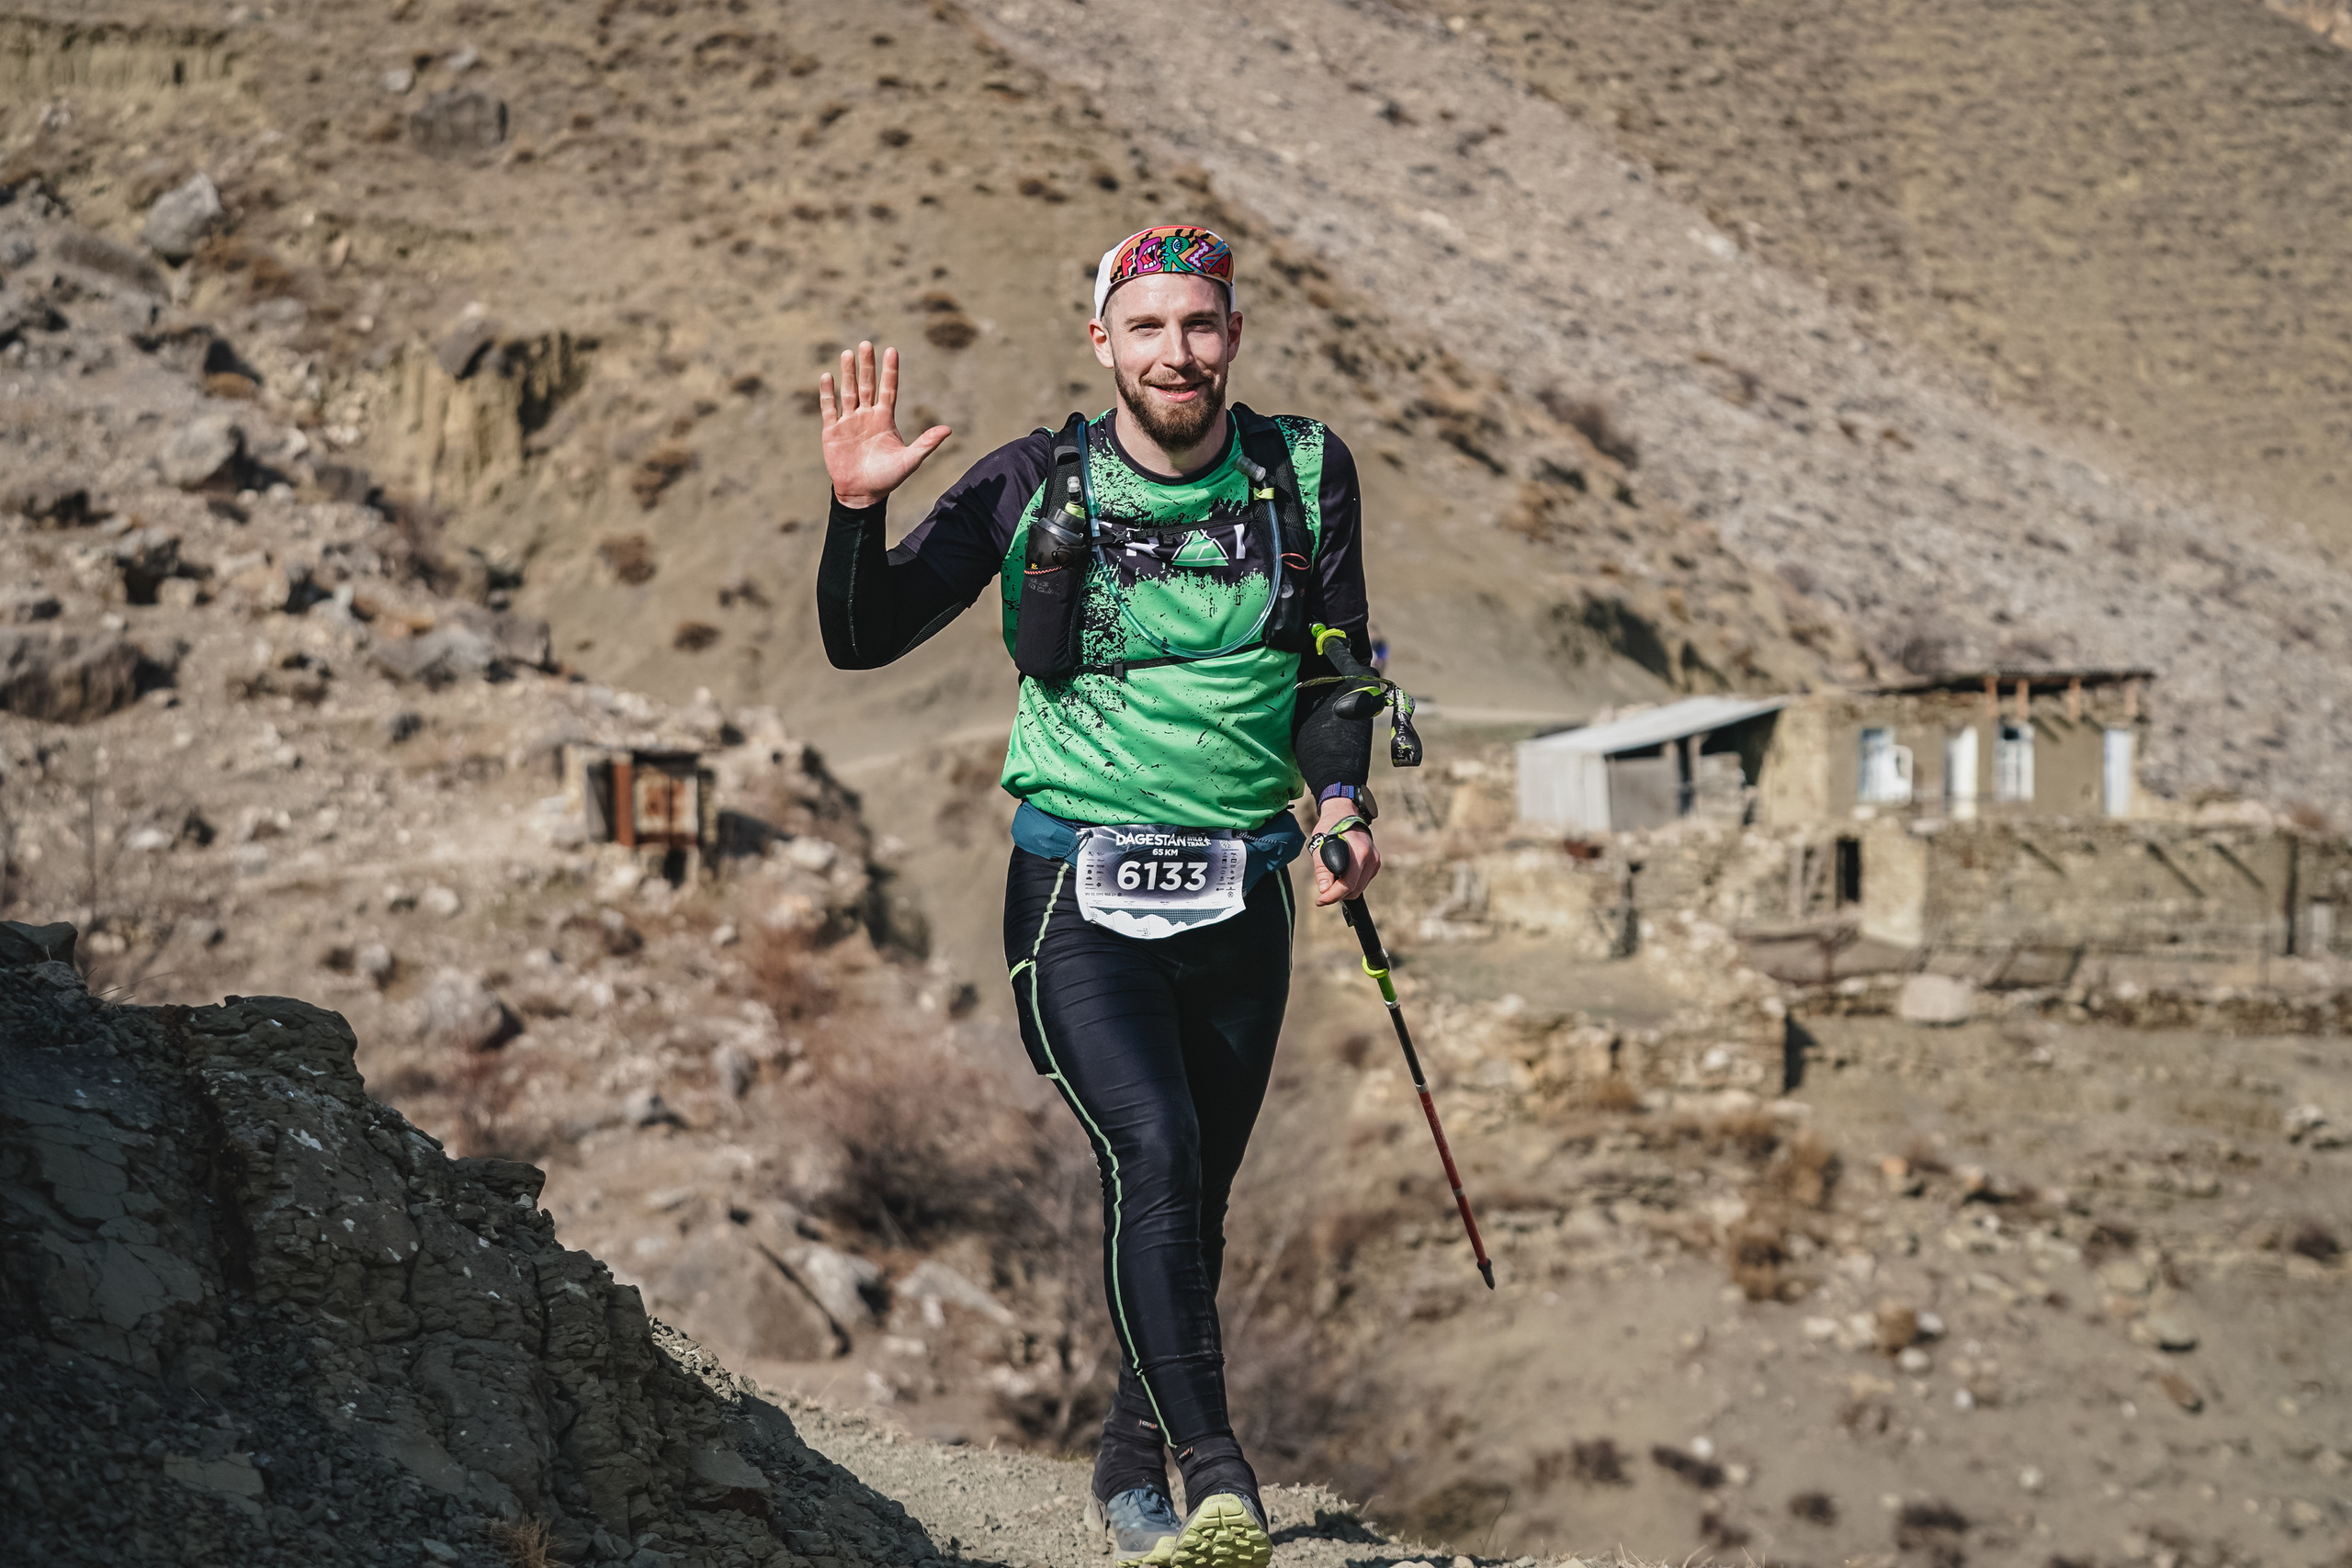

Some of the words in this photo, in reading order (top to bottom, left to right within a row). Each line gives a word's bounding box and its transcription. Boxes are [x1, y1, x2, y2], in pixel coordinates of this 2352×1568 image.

[1121, 235, 1231, 277] FORZA
[1115, 831, 1187, 847] DAGESTAN
[1117, 861, 1208, 892] 6133
